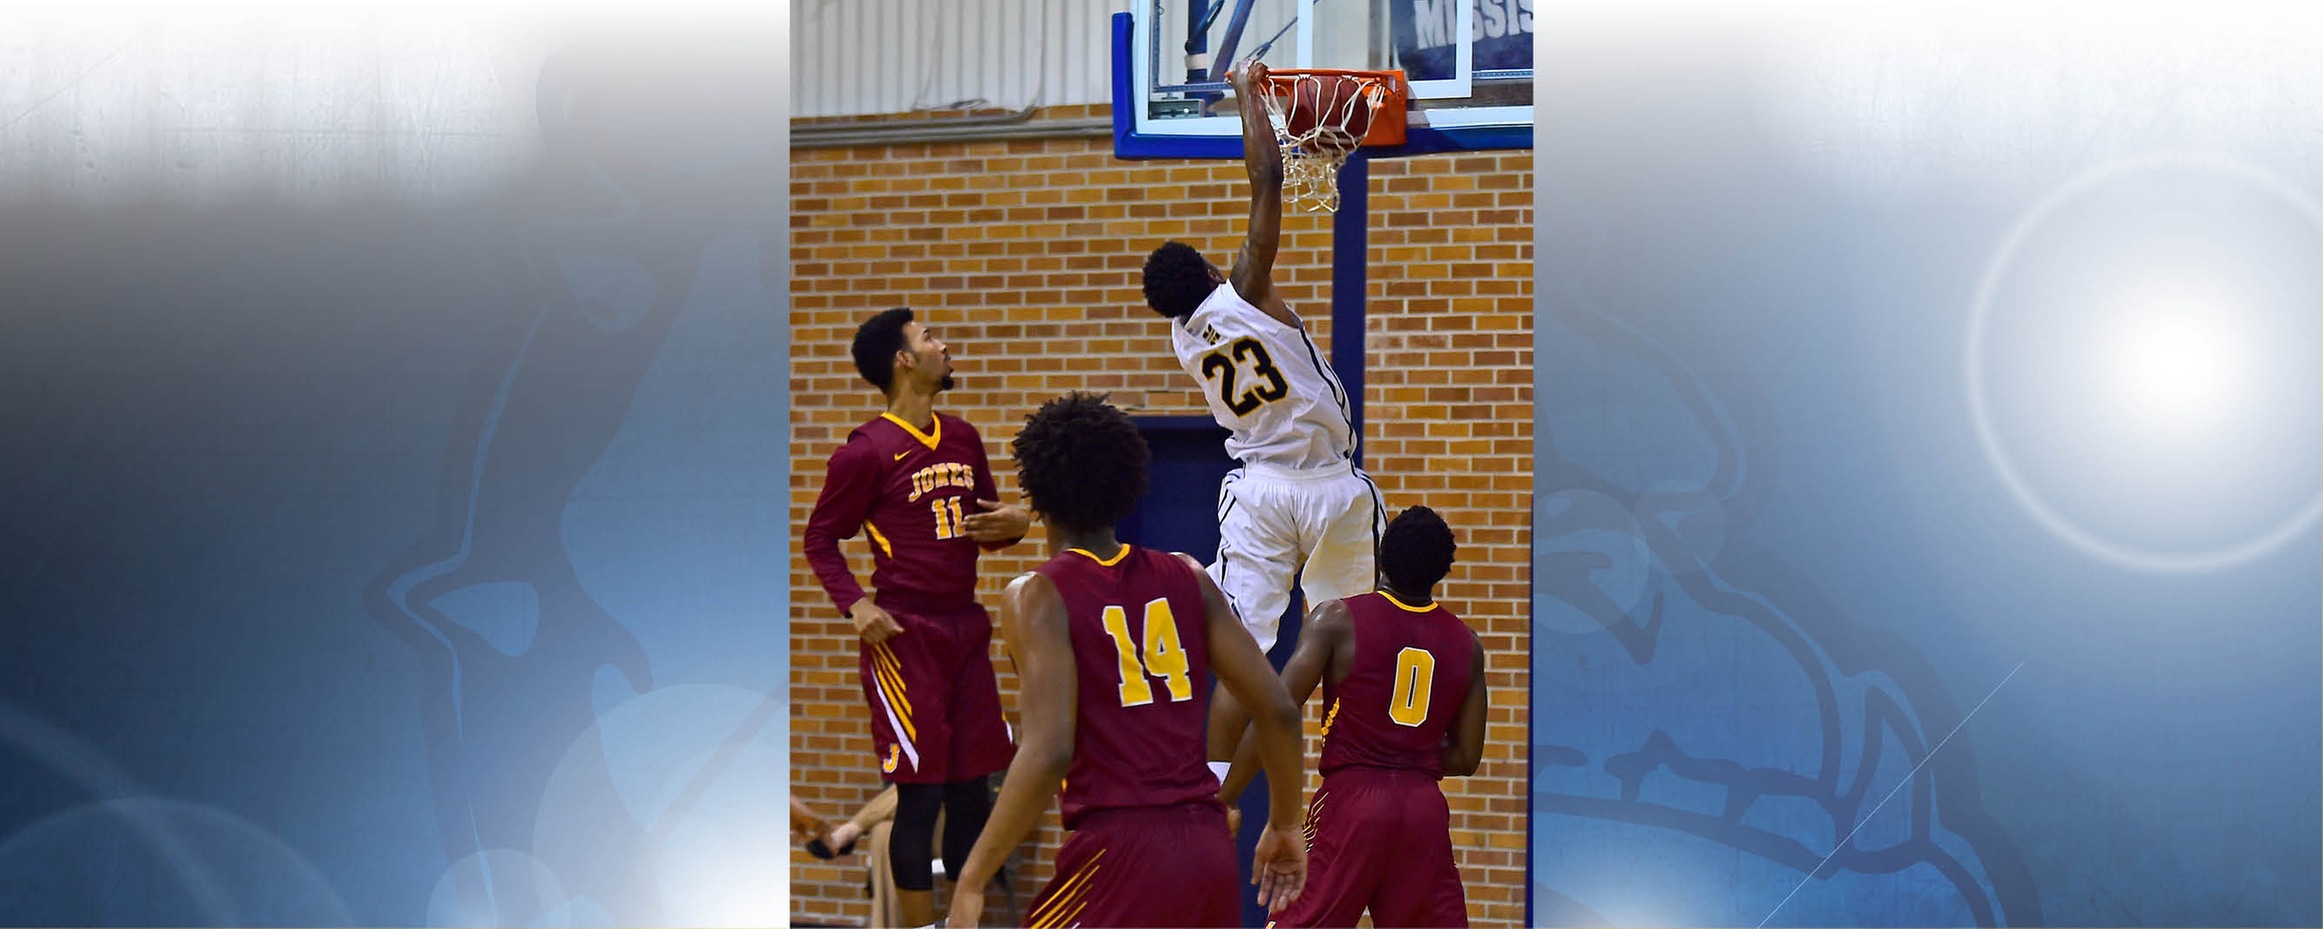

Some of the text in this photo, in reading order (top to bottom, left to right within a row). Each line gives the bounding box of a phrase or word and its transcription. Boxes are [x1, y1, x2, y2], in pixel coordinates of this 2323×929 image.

[1201, 336, 1290, 417] 23
[908, 462, 974, 502] JONES
[931, 496, 966, 540] 11
[1101, 597, 1193, 707] 14
[1388, 646, 1435, 727] 0
[882, 742, 900, 773] J
